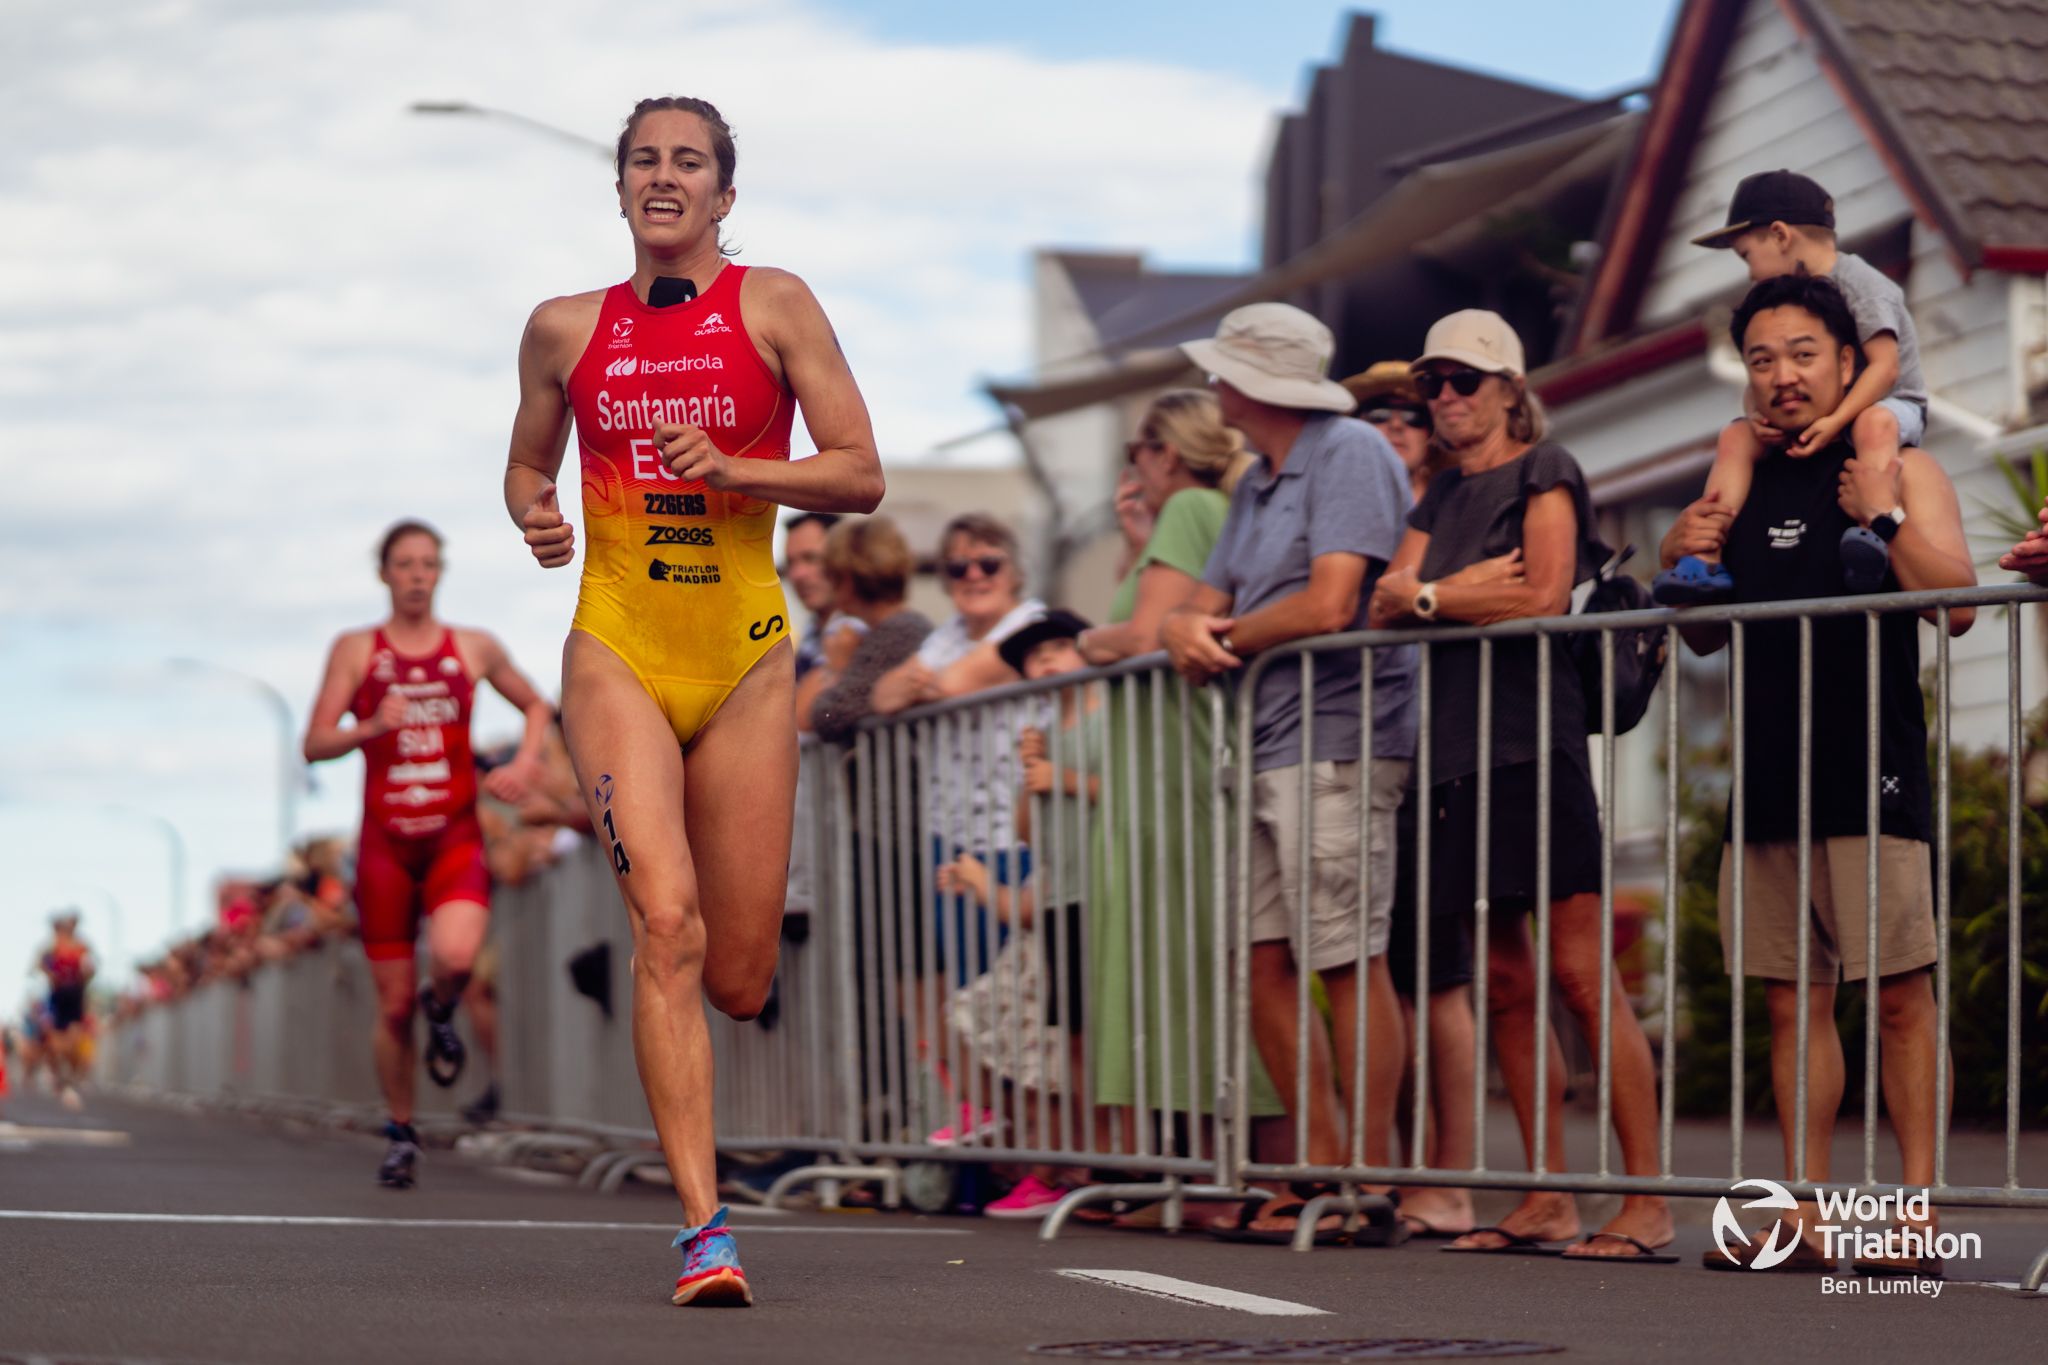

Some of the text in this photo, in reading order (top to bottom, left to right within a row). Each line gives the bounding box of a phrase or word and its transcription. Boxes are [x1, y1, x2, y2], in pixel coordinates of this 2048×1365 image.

[640, 354, 723, 375] Iberdrola
[597, 385, 736, 431] Santamaría
[644, 493, 706, 515] 226ERS
[672, 564, 719, 574] TRIATLON
[673, 574, 721, 584] MADRID
[603, 807, 632, 876] 14
